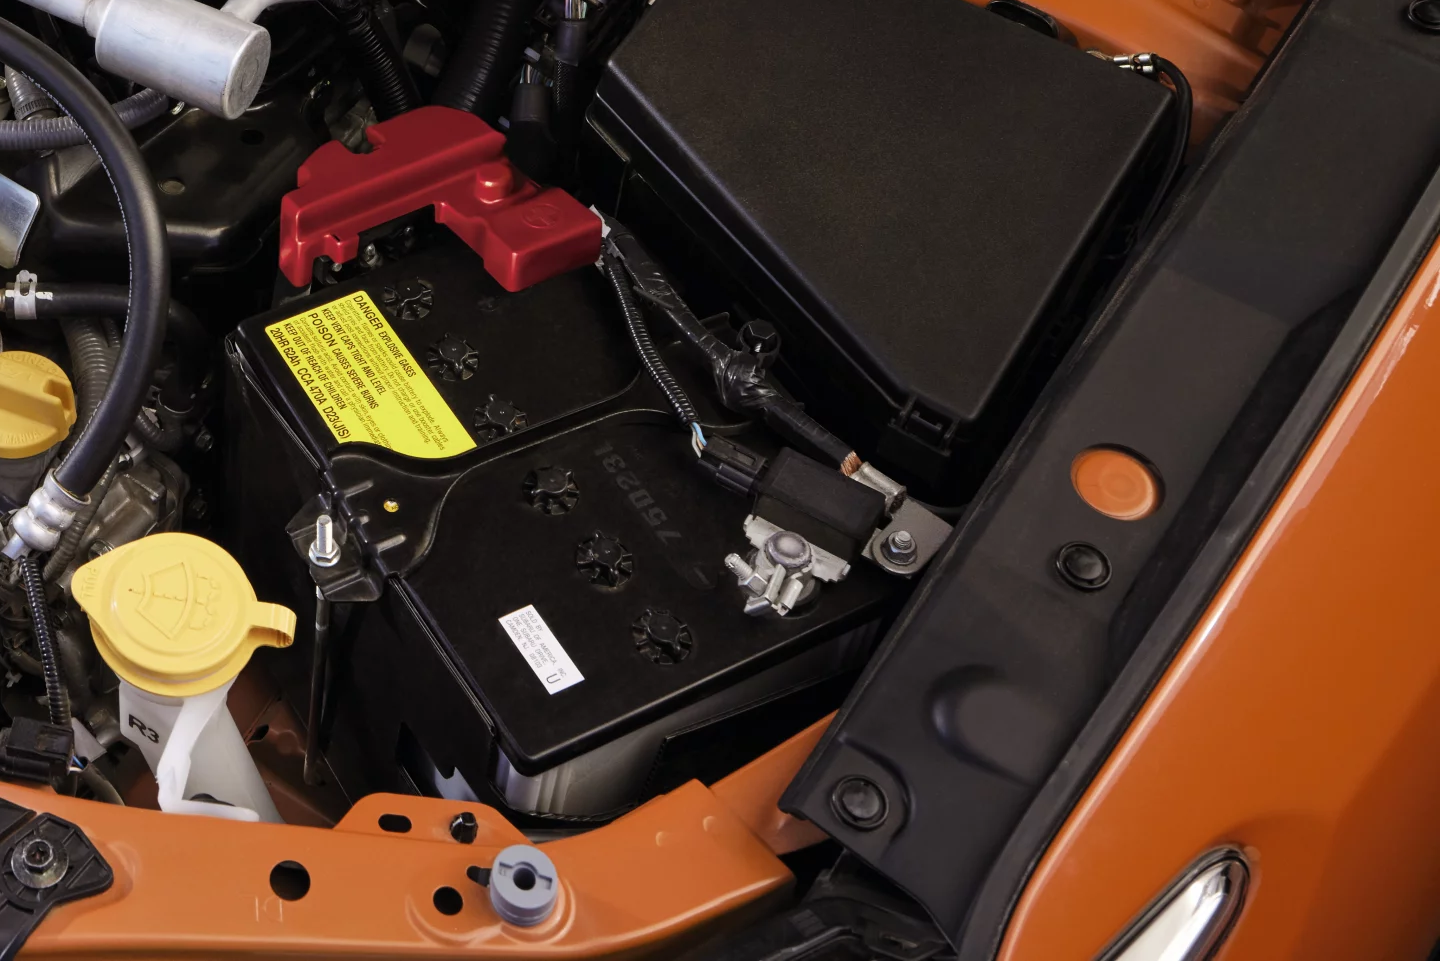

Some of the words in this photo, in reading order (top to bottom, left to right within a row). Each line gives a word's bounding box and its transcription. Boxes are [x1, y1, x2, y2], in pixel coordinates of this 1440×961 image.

[283, 322, 298, 336] KEEP
[352, 295, 384, 329] DANGER
[377, 331, 404, 358] EXPLOSIVE
[397, 359, 417, 377] GASES
[292, 336, 305, 347] OUT
[299, 347, 311, 355] OF
[321, 308, 336, 321] KEEP
[330, 321, 345, 335] VENT
[339, 335, 356, 349] CAPS
[349, 349, 367, 365] TIGHT
[361, 365, 376, 377] AND
[369, 377, 388, 395] LEVEL
[305, 355, 323, 373] REACH
[307, 312, 337, 346] POISON
[331, 347, 352, 369] CAUSES
[345, 369, 366, 389] SEVERE
[359, 389, 380, 409] BURNS
[269, 327, 290, 347] 20HR
[282, 346, 302, 366] 62Ah
[296, 367, 316, 385] CCA
[307, 385, 329, 404] 470A
[321, 406, 352, 438] D23(JIS)
[317, 373, 329, 382] OF
[322, 381, 348, 409] CHILDREN
[391, 378, 401, 386] not
[418, 417, 436, 434] booster
[401, 382, 419, 399] battery
[432, 425, 450, 442] Always
[408, 415, 419, 424] and
[518, 613, 535, 632] SUBARU
[525, 610, 537, 623] SOLD
[512, 616, 522, 626] ONE
[520, 628, 536, 647] SUBARU
[546, 673, 561, 684] U
[128, 713, 160, 745] R3
